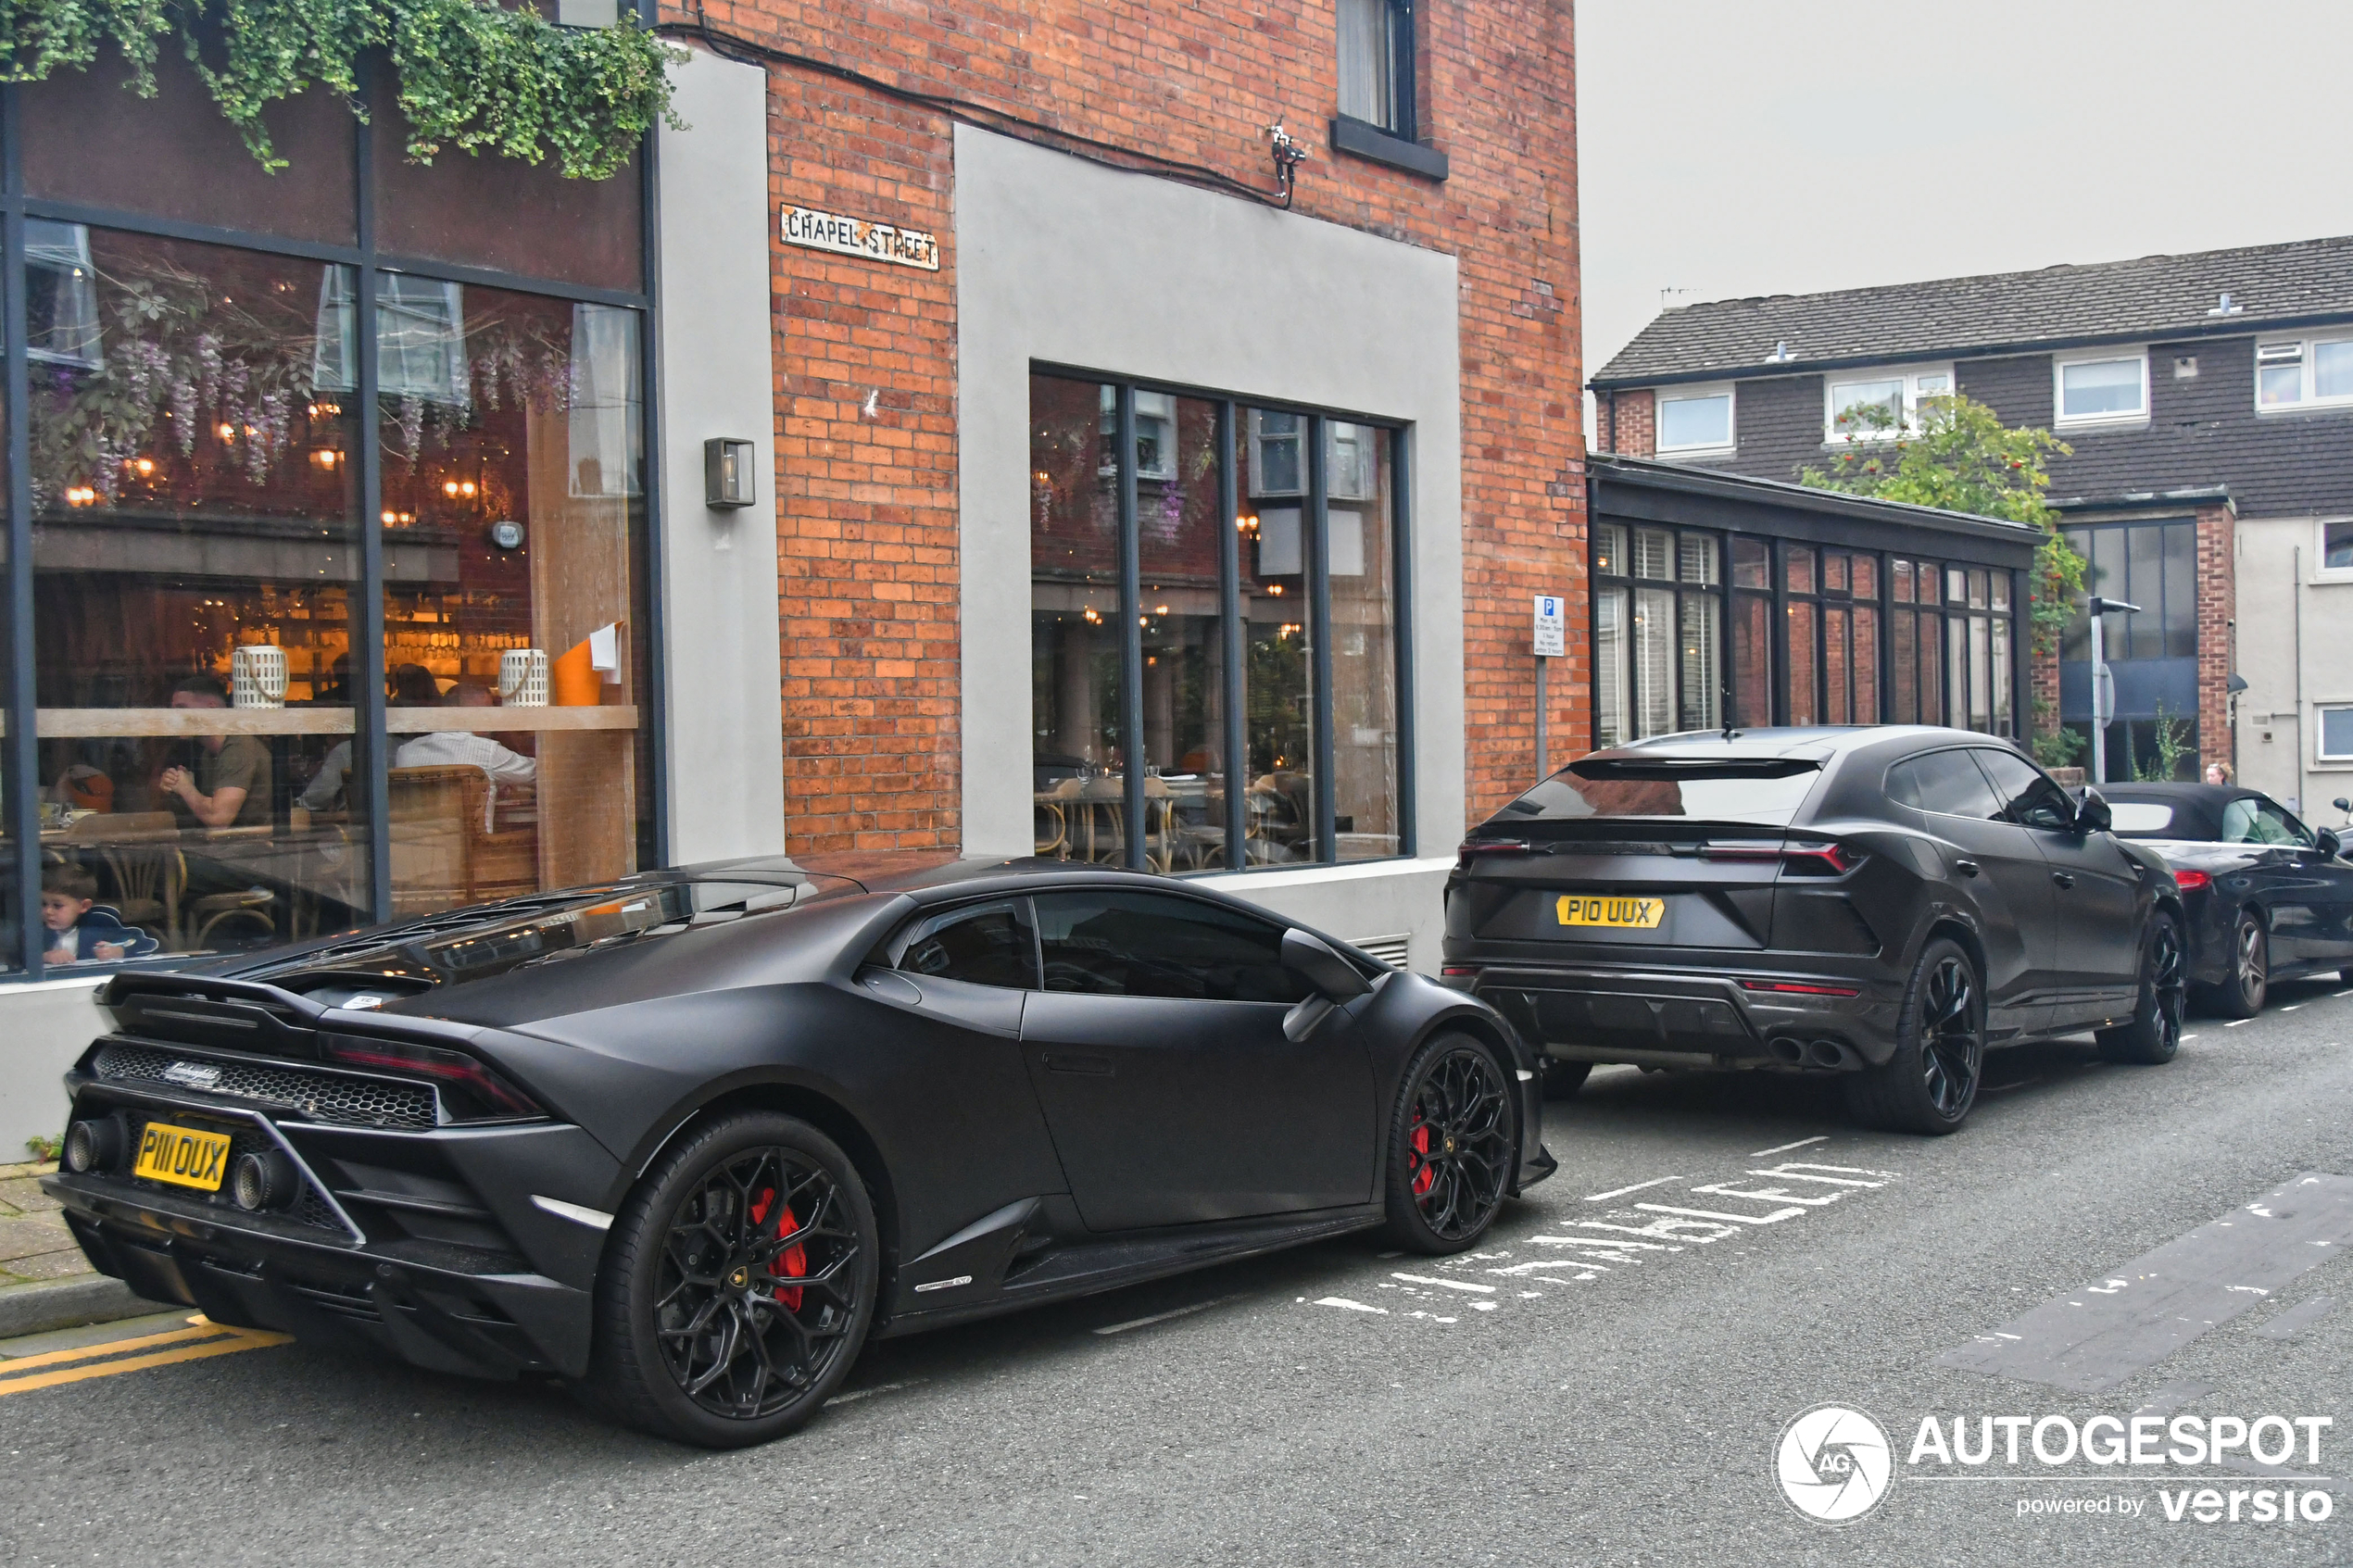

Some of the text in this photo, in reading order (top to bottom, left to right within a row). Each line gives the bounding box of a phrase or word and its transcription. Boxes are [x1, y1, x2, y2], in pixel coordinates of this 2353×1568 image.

[788, 213, 936, 264] CHAPEL STREET
[1567, 900, 1651, 923] P10 UUX
